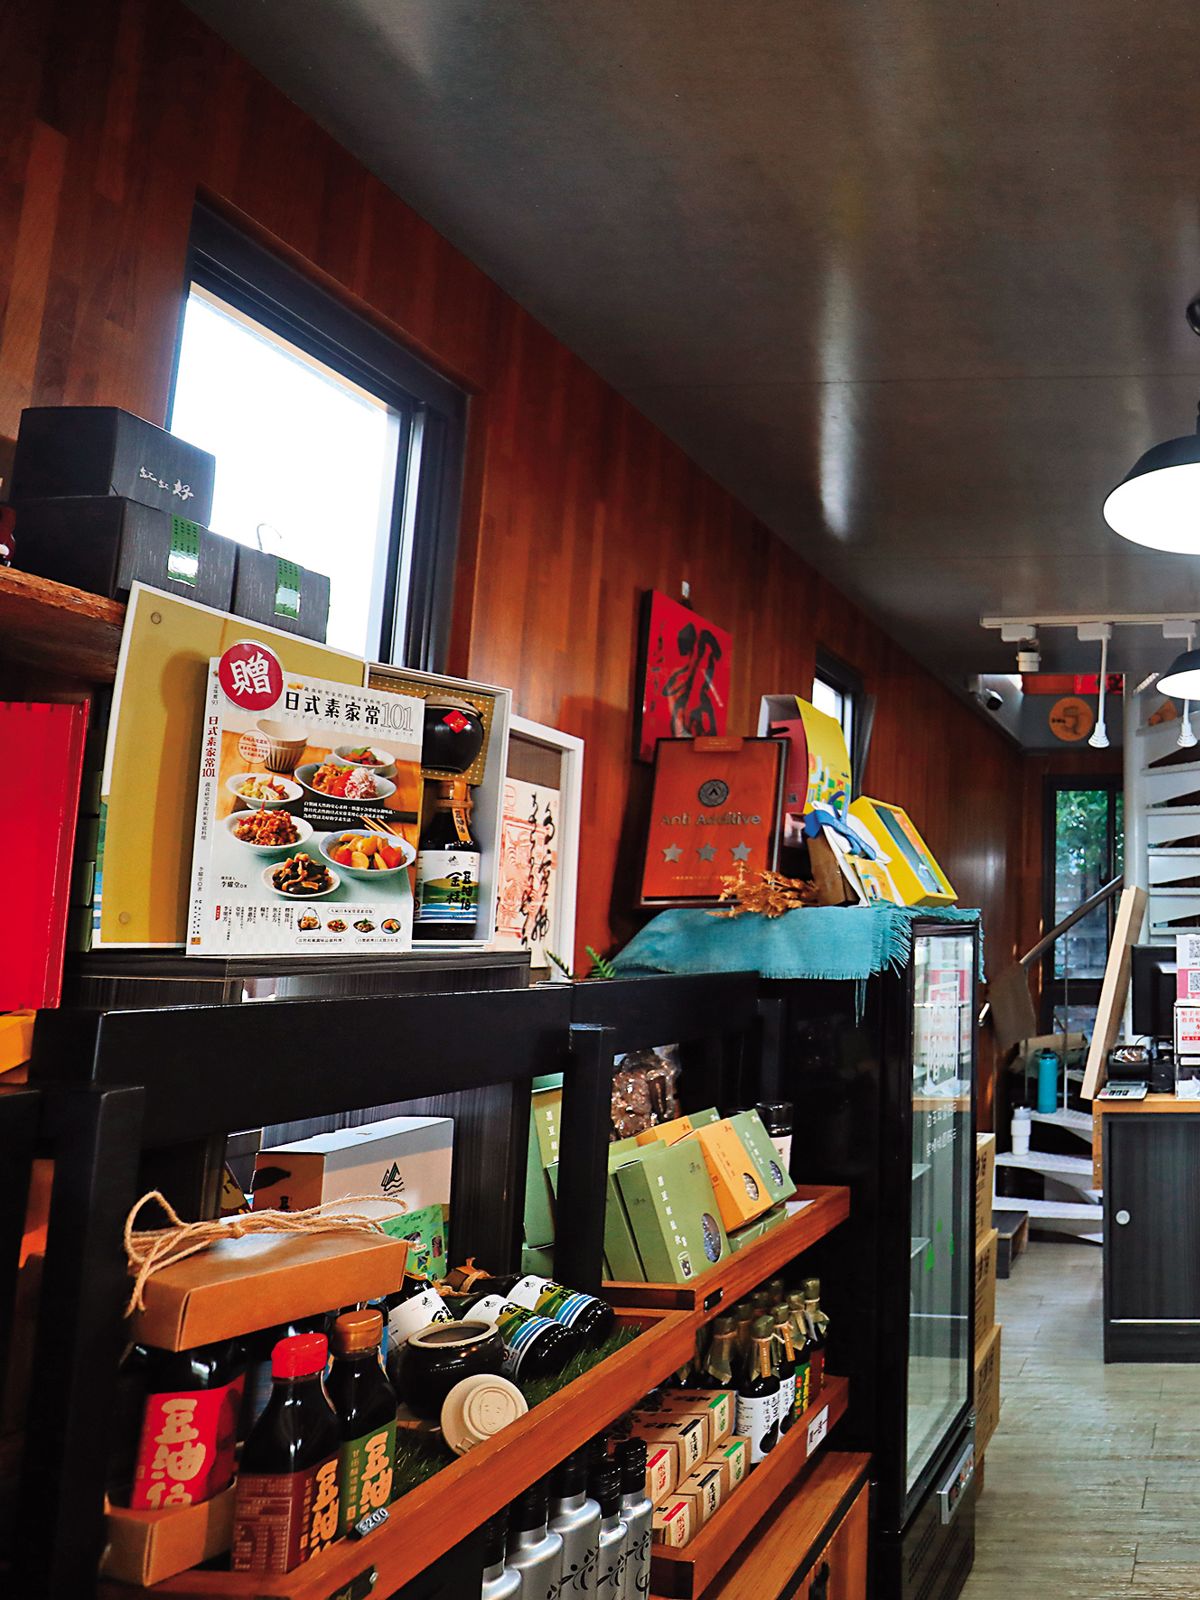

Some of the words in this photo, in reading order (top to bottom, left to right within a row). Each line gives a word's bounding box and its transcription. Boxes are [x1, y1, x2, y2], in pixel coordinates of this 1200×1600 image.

[229, 651, 273, 696] 贈
[661, 812, 691, 826] Anti
[460, 870, 472, 912] 豆油伯
[360, 1430, 394, 1516] 豆油
[310, 1458, 340, 1558] 豆油
